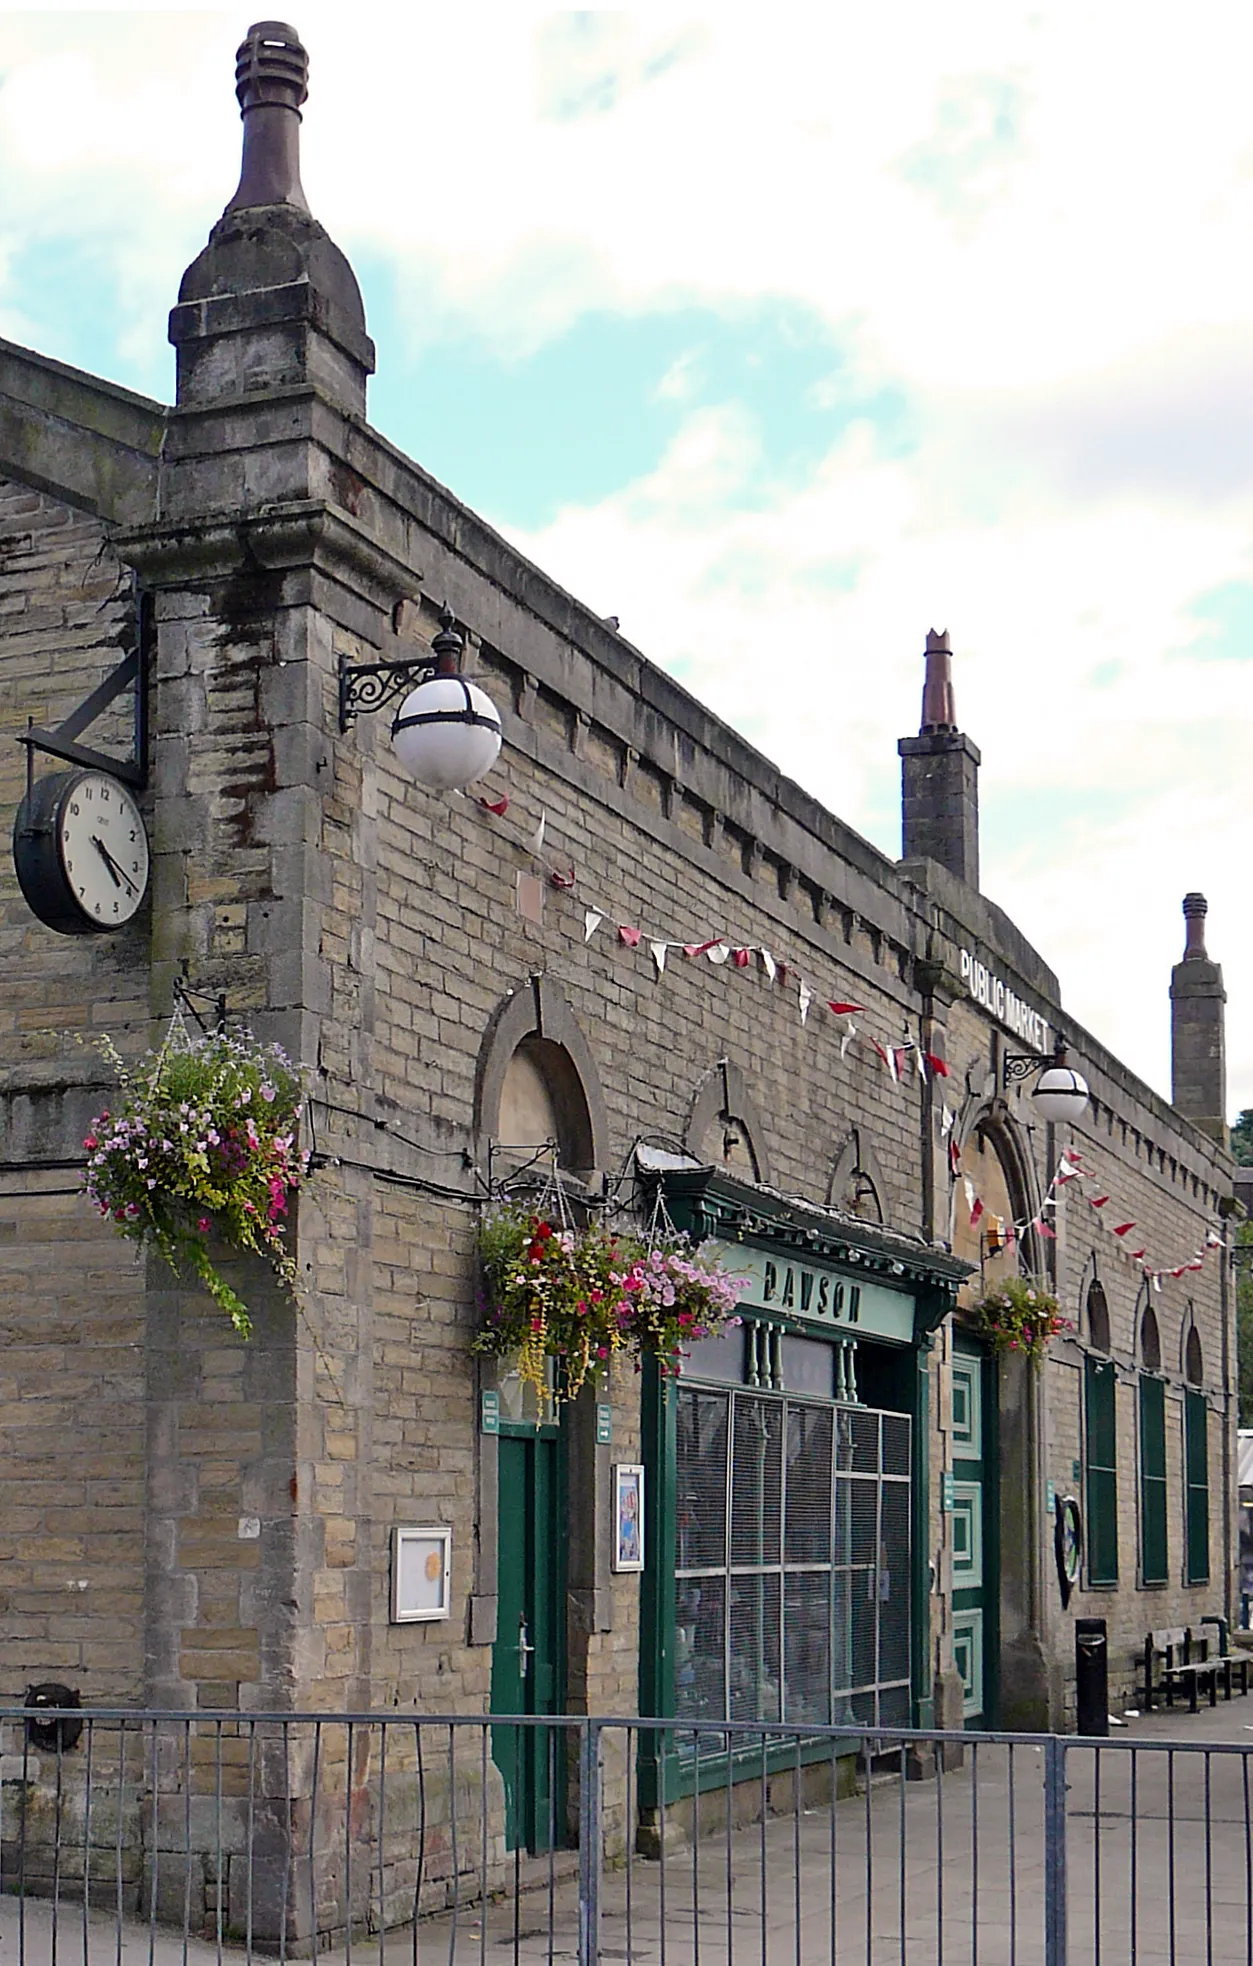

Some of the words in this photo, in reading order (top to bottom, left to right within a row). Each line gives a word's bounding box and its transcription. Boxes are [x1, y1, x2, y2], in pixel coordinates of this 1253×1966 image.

[85, 787, 93, 800] 11
[100, 788, 110, 801] 12
[70, 802, 80, 816] 10
[119, 802, 124, 815] 1
[64, 830, 70, 842] 9
[129, 830, 137, 842] 2
[67, 860, 73, 872] 8
[132, 861, 139, 873] 3
[79, 887, 86, 898] 7
[125, 886, 132, 897] 4
[95, 903, 101, 914] 6
[112, 901, 120, 913] 5
[960, 948, 1004, 1020] PUBLIC
[1005, 988, 1049, 1055] MARKET
[763, 1260, 861, 1323] DAWSON
